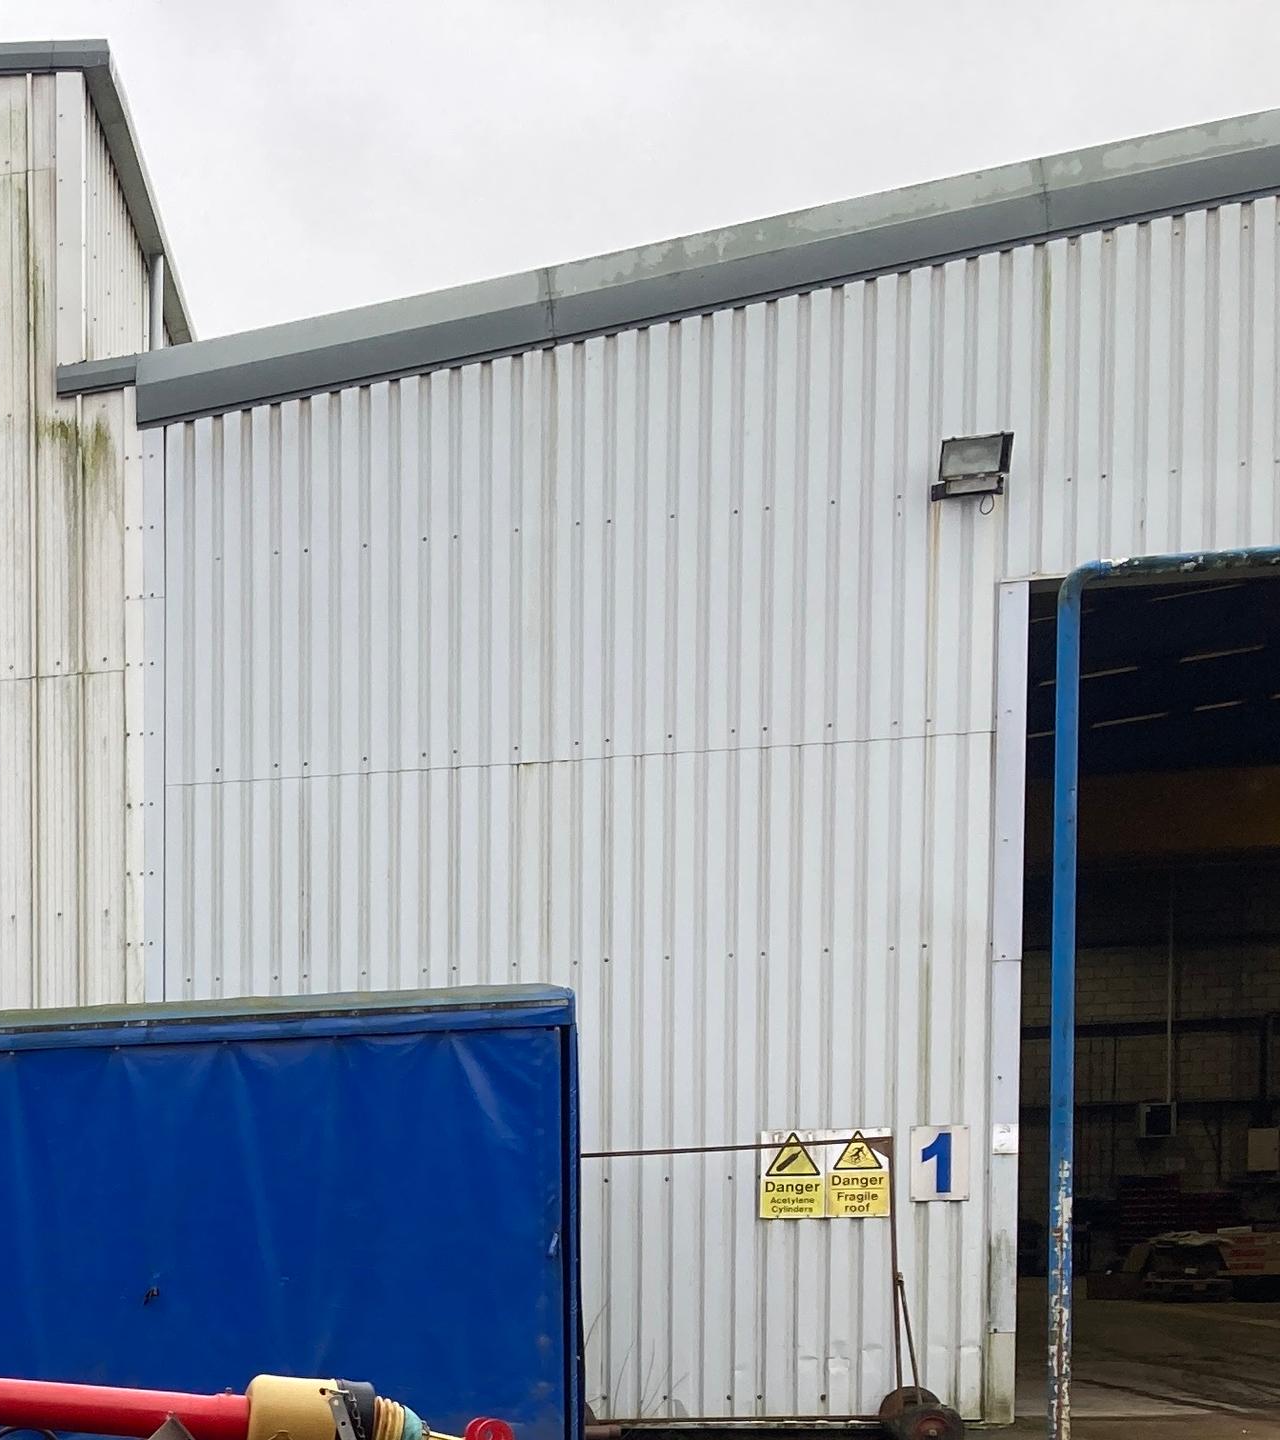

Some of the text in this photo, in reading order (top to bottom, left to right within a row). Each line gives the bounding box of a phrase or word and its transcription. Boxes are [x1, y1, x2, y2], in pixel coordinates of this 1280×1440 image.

[921, 1132, 952, 1193] 1
[831, 1175, 884, 1188] Danger
[765, 1181, 820, 1195] Danger
[770, 1196, 815, 1205] Acetylene
[837, 1191, 878, 1203] Fragile
[771, 1205, 813, 1214] Cylinders
[844, 1202, 870, 1213] roof
